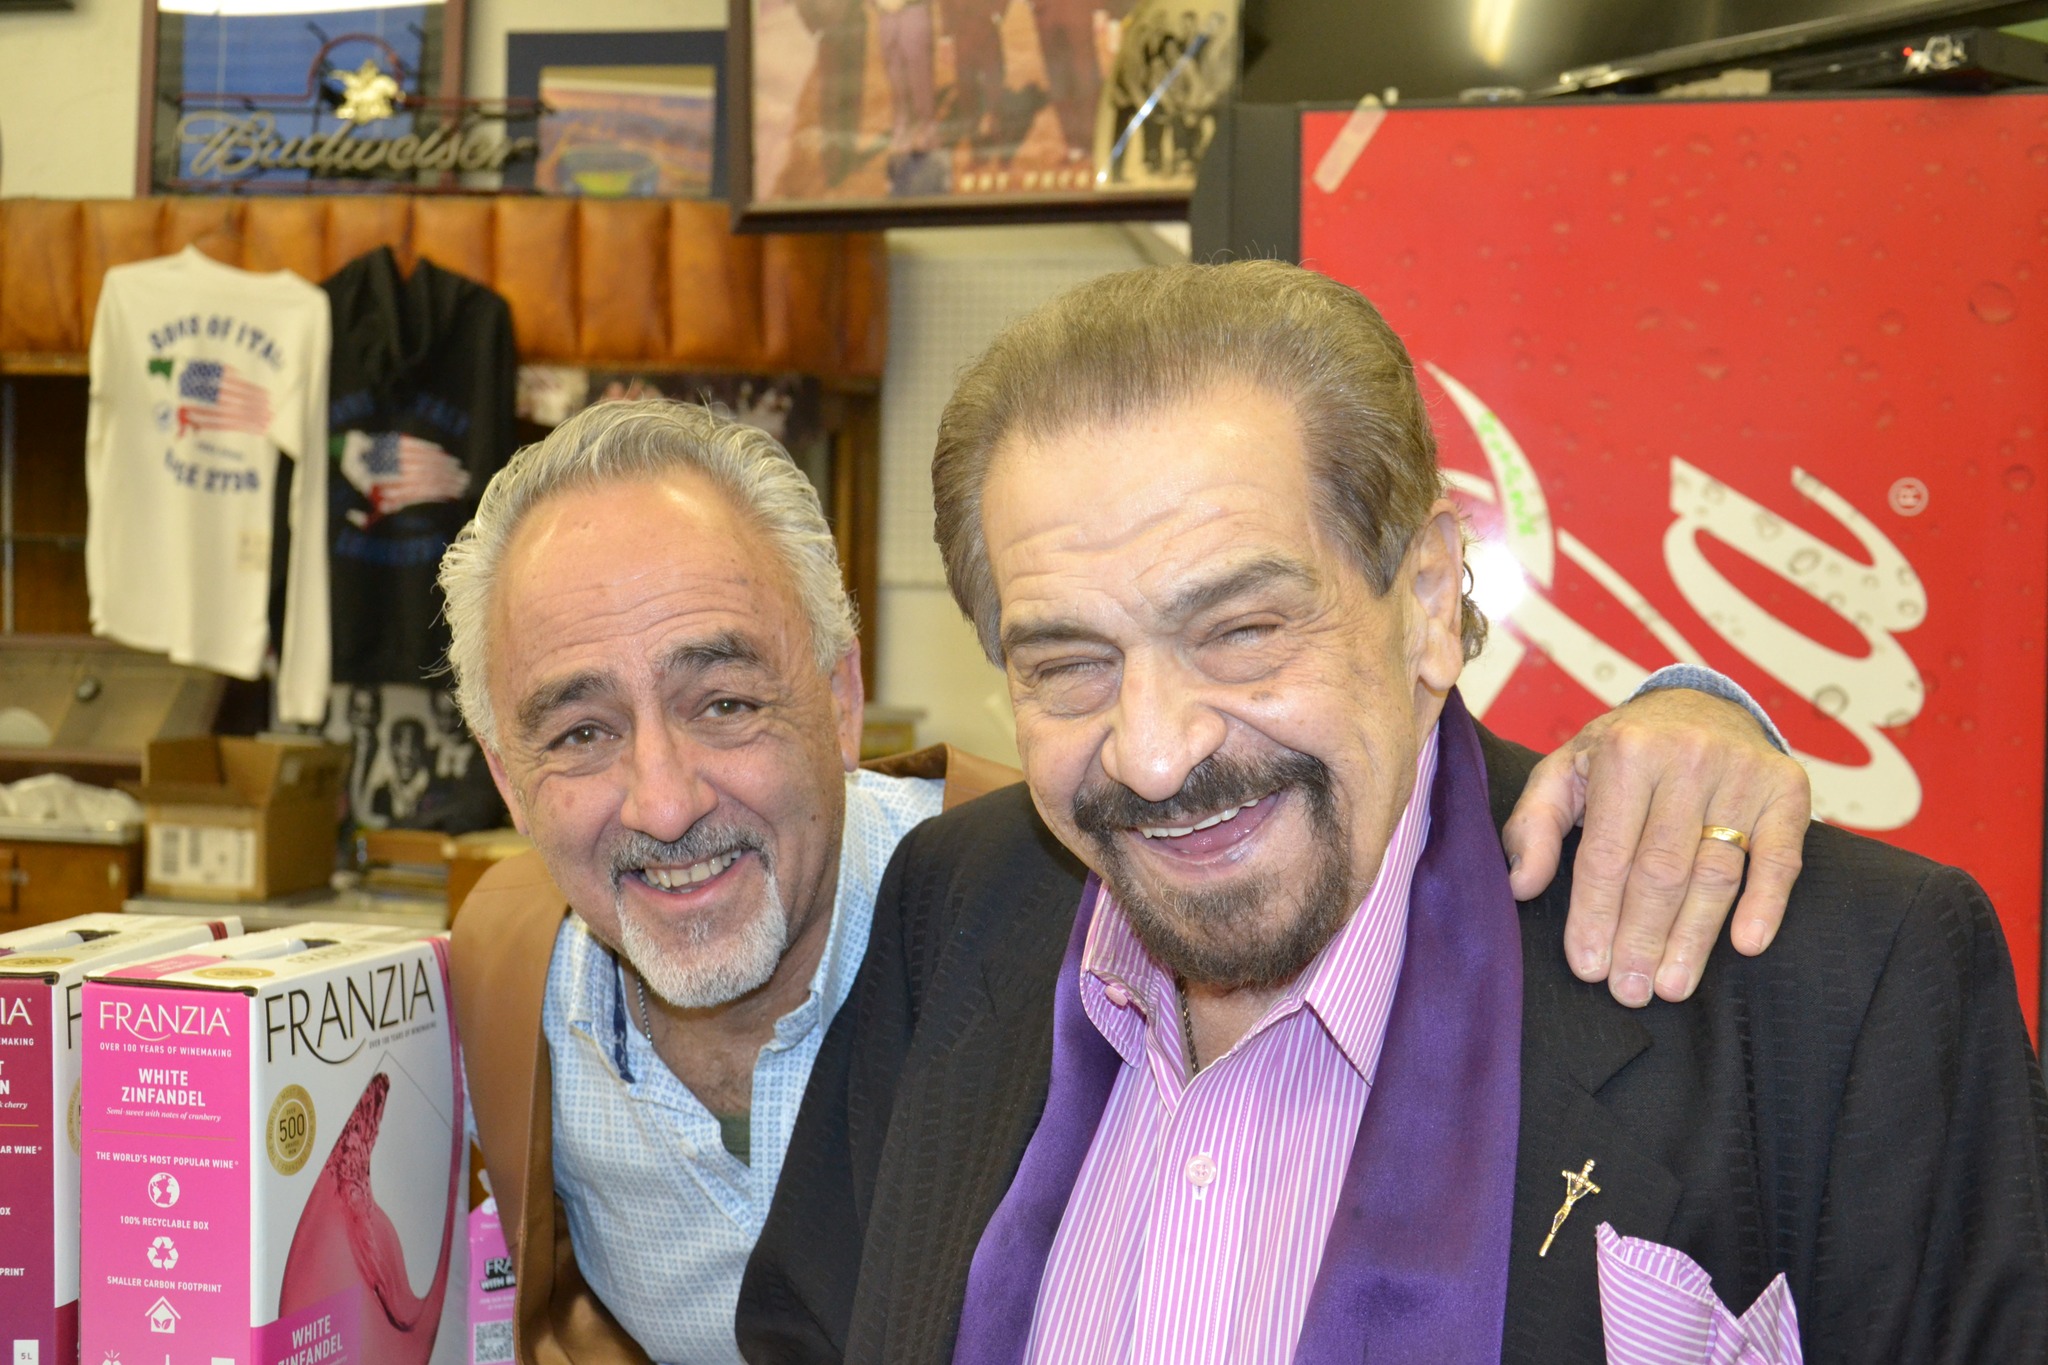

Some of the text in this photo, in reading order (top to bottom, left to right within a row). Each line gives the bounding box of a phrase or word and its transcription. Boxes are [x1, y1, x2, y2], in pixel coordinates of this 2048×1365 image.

[177, 109, 535, 176] Budweiser
[265, 957, 435, 1065] FRANZIA
[99, 1001, 231, 1042] FRANZIA
[0, 1037, 34, 1046] MAKING
[100, 1042, 232, 1058] OVER 100 YEARS OF WINEMAKING
[138, 1068, 189, 1086] WHITE
[121, 1086, 206, 1107] ZINFANDEL
[4, 1100, 28, 1110] cherry
[145, 1109, 160, 1118] with
[161, 1111, 179, 1119] notes
[180, 1112, 188, 1120] of
[188, 1113, 221, 1123] cranberry
[279, 1113, 305, 1142] 500
[96, 1151, 110, 1160] THE
[112, 1152, 147, 1163] WORLD'S
[150, 1155, 171, 1165] MOST
[174, 1156, 210, 1167] POPULAR
[0, 1207, 11, 1216] OX
[120, 1215, 209, 1230] 100% RECYCLABLE BOX
[0, 1268, 25, 1276] PRINT
[107, 1276, 222, 1293] SMALLER CARBON FOOTPRINT
[292, 1315, 331, 1350] WHITE
